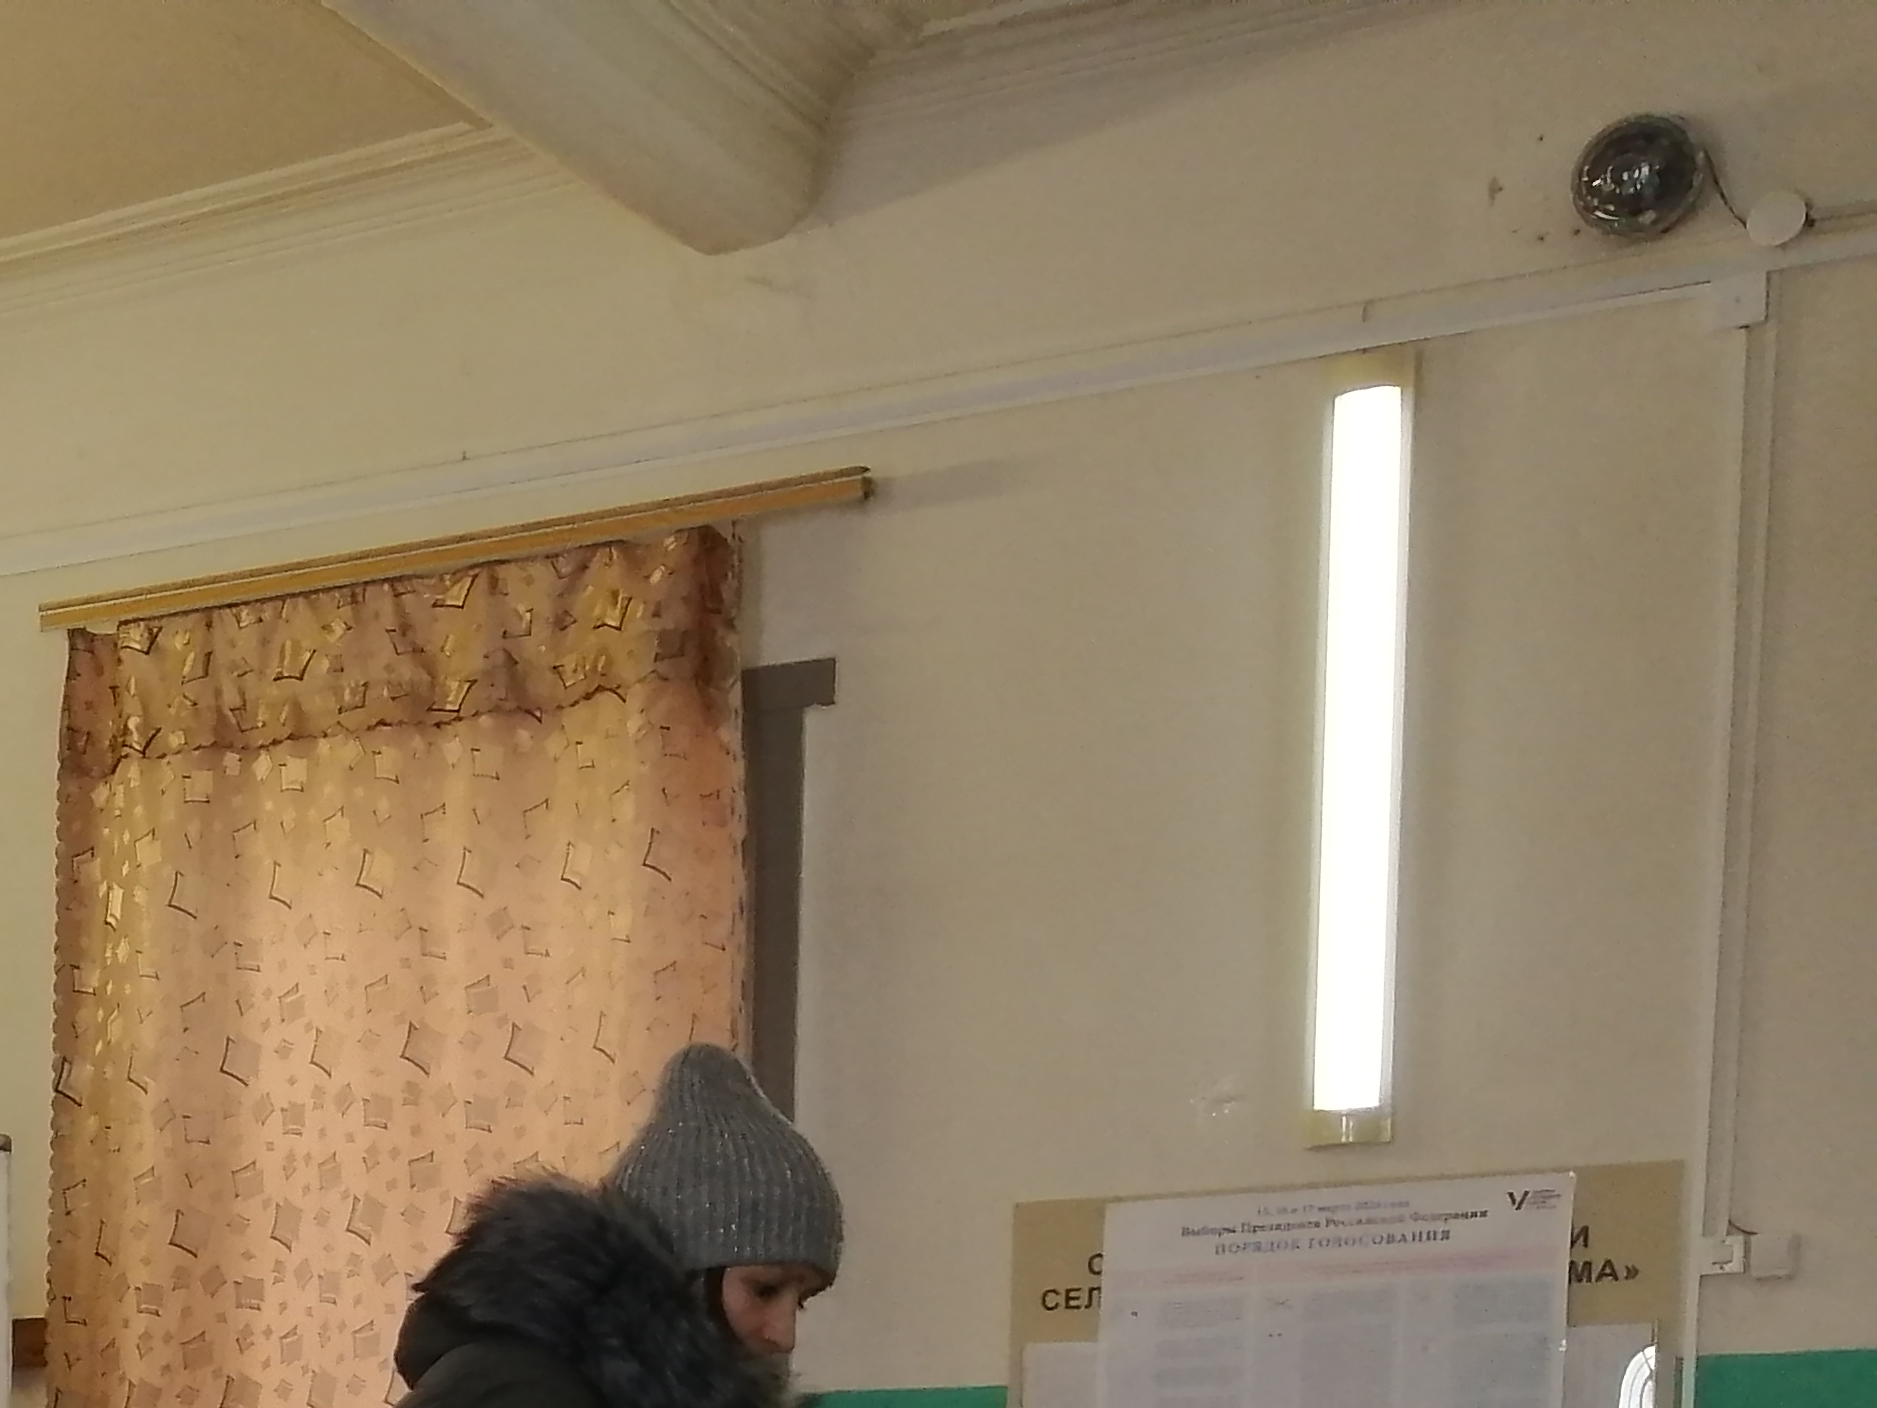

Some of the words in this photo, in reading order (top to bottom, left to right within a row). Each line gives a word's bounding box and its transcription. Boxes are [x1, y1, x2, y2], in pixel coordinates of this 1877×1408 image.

[1215, 1239, 1300, 1255] ПОРЯДОК
[1308, 1229, 1451, 1251] ГОЛОСОВАНИЯ
[1041, 1286, 1102, 1311] СЕЛ
[1568, 1258, 1641, 1285] МА»
